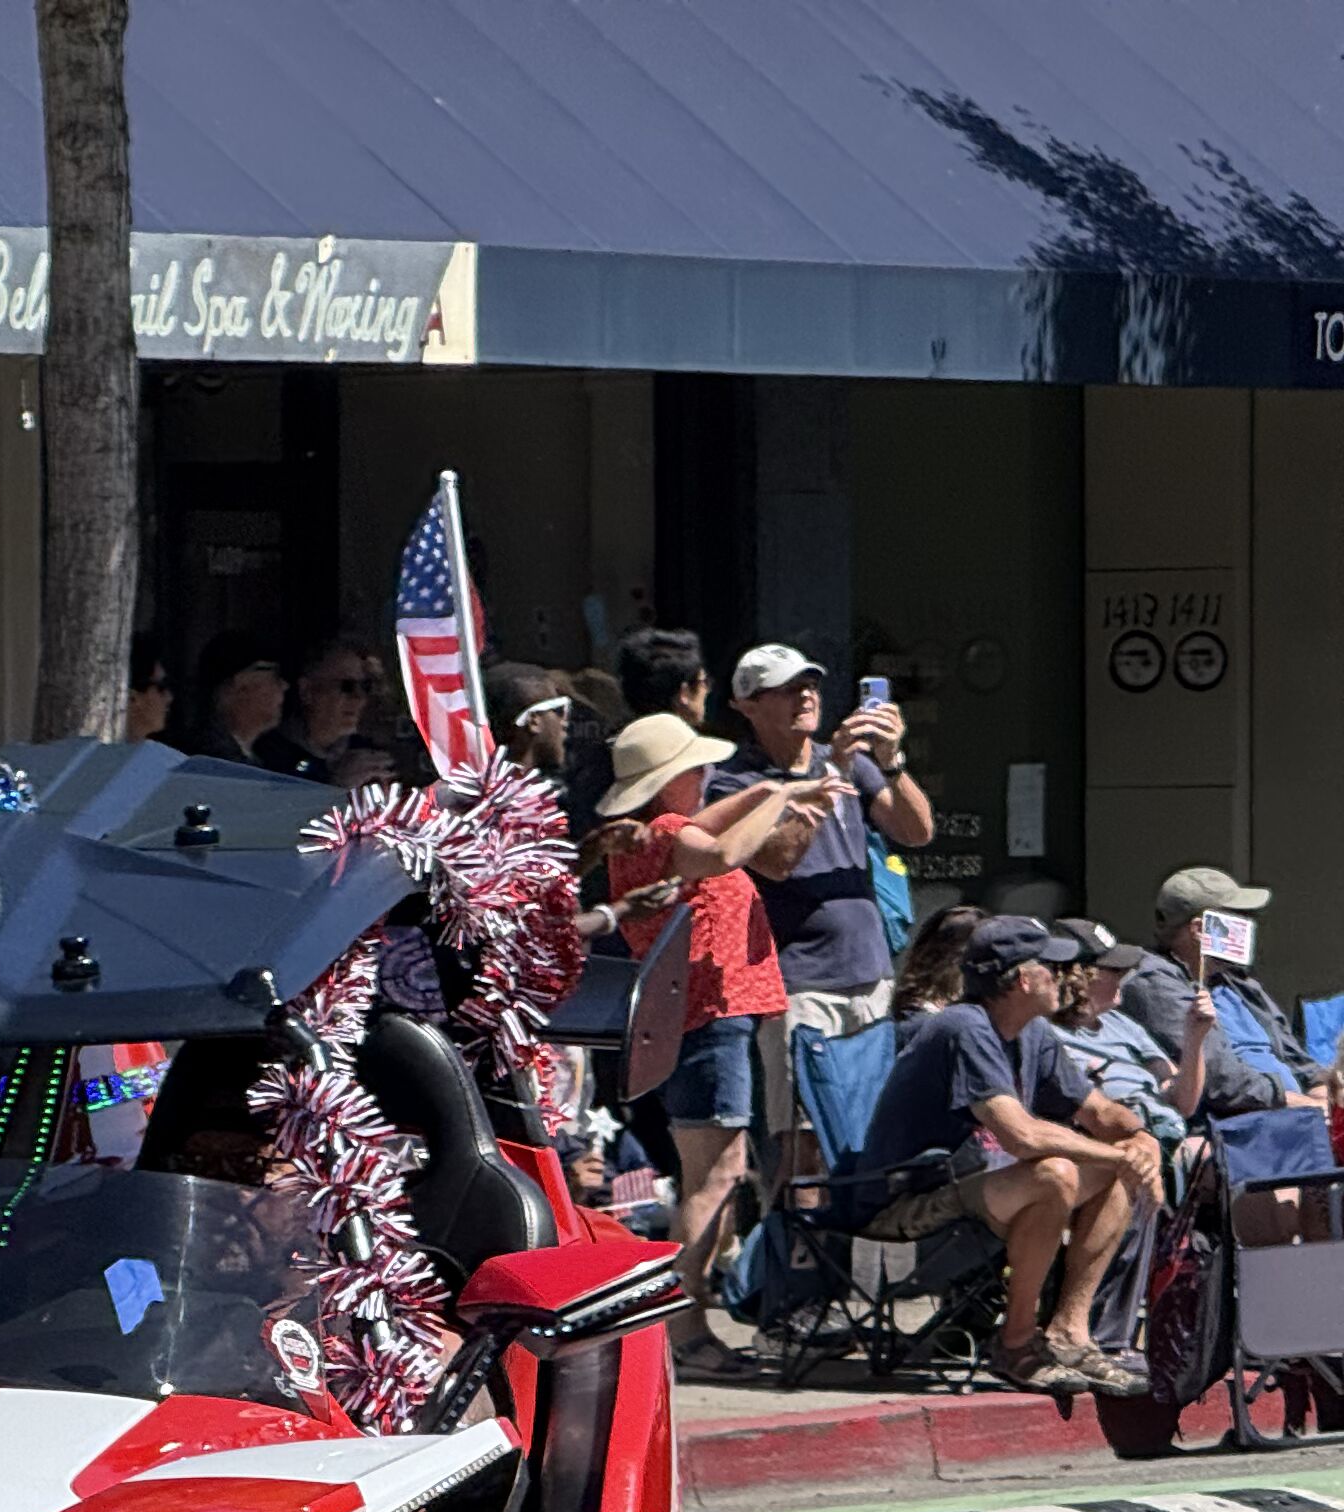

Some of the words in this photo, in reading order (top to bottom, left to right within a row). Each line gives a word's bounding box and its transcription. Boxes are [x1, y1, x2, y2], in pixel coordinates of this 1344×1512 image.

[184, 257, 250, 353] Spa
[261, 252, 294, 339] &
[295, 259, 421, 360] Waxing
[1103, 592, 1158, 628] 1413
[1171, 592, 1223, 626] 1411
